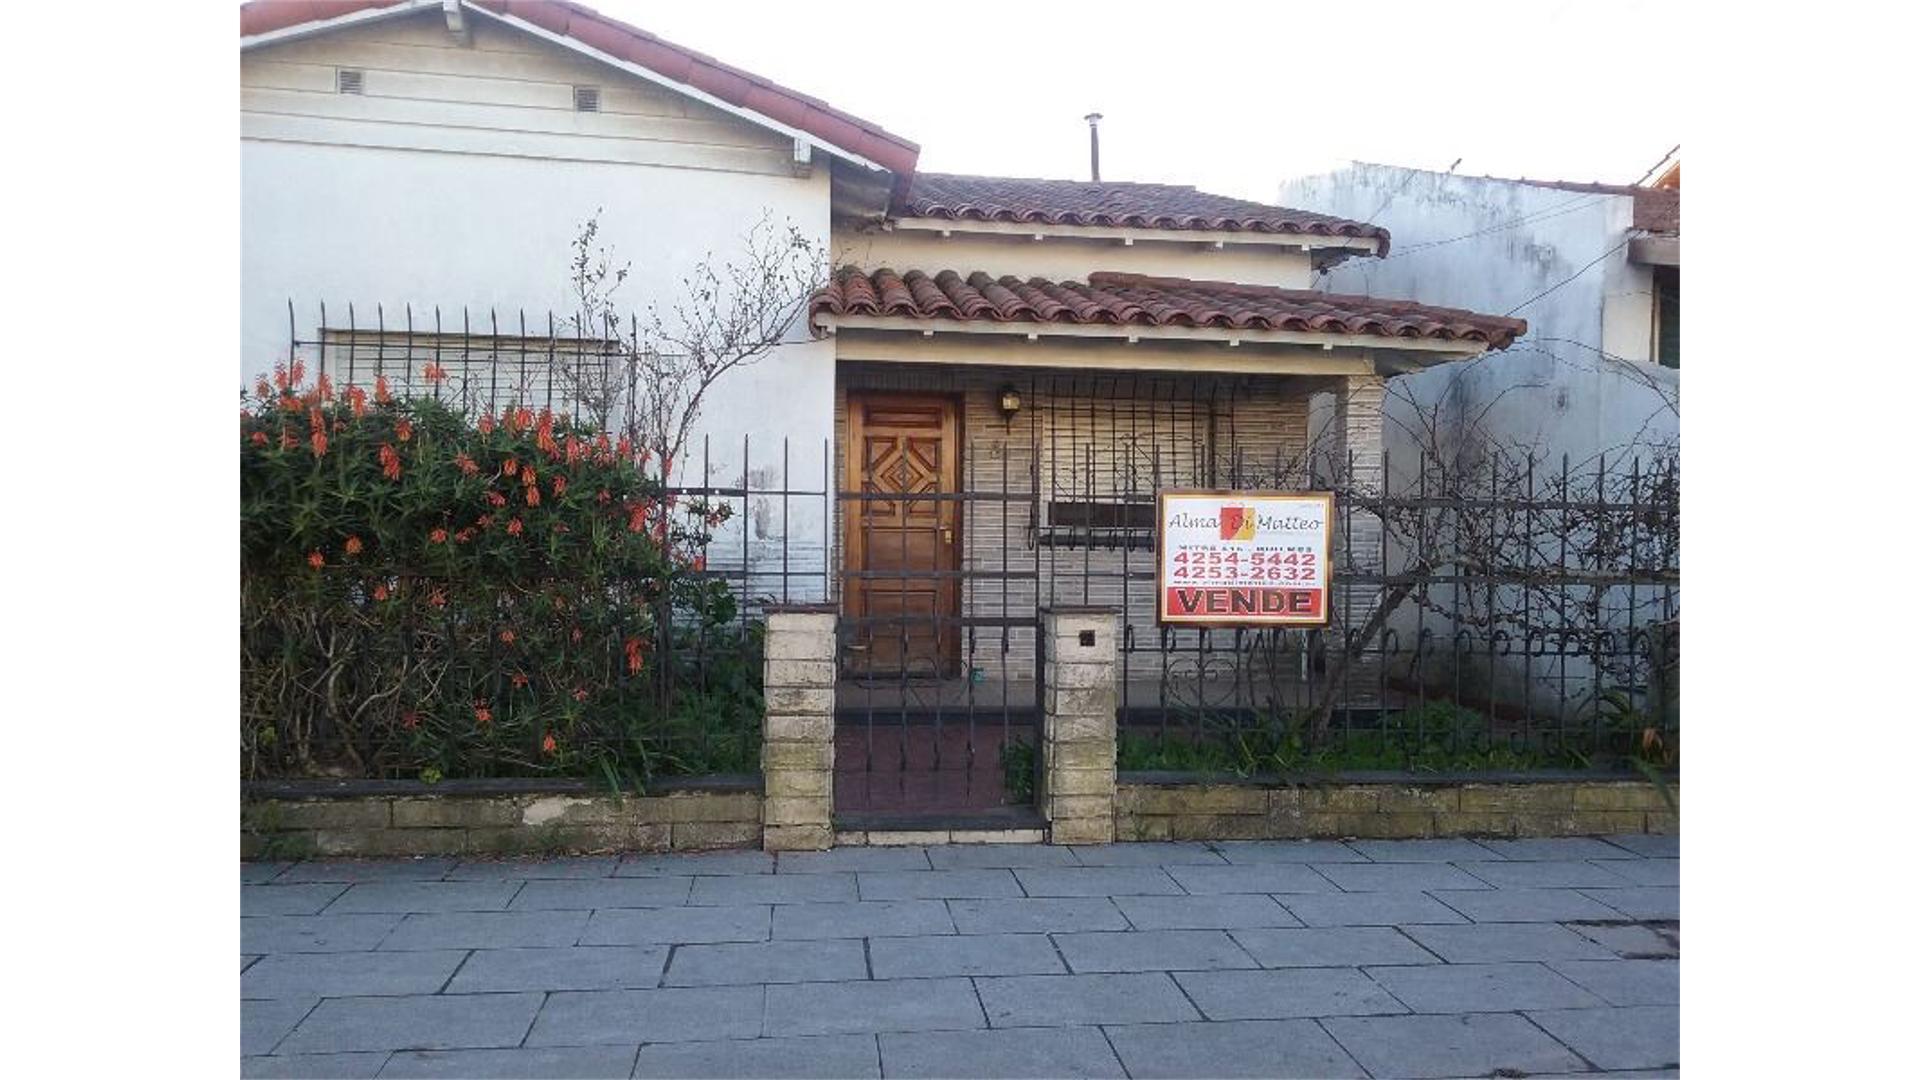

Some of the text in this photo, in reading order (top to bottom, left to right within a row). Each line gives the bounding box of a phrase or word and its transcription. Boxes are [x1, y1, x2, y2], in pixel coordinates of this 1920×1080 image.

[1168, 512, 1220, 529] Alma
[1257, 514, 1323, 531] Matteo
[1173, 552, 1316, 566] 4254-5442
[1173, 566, 1316, 580] 4253-2632
[1177, 589, 1312, 613] VENDE
